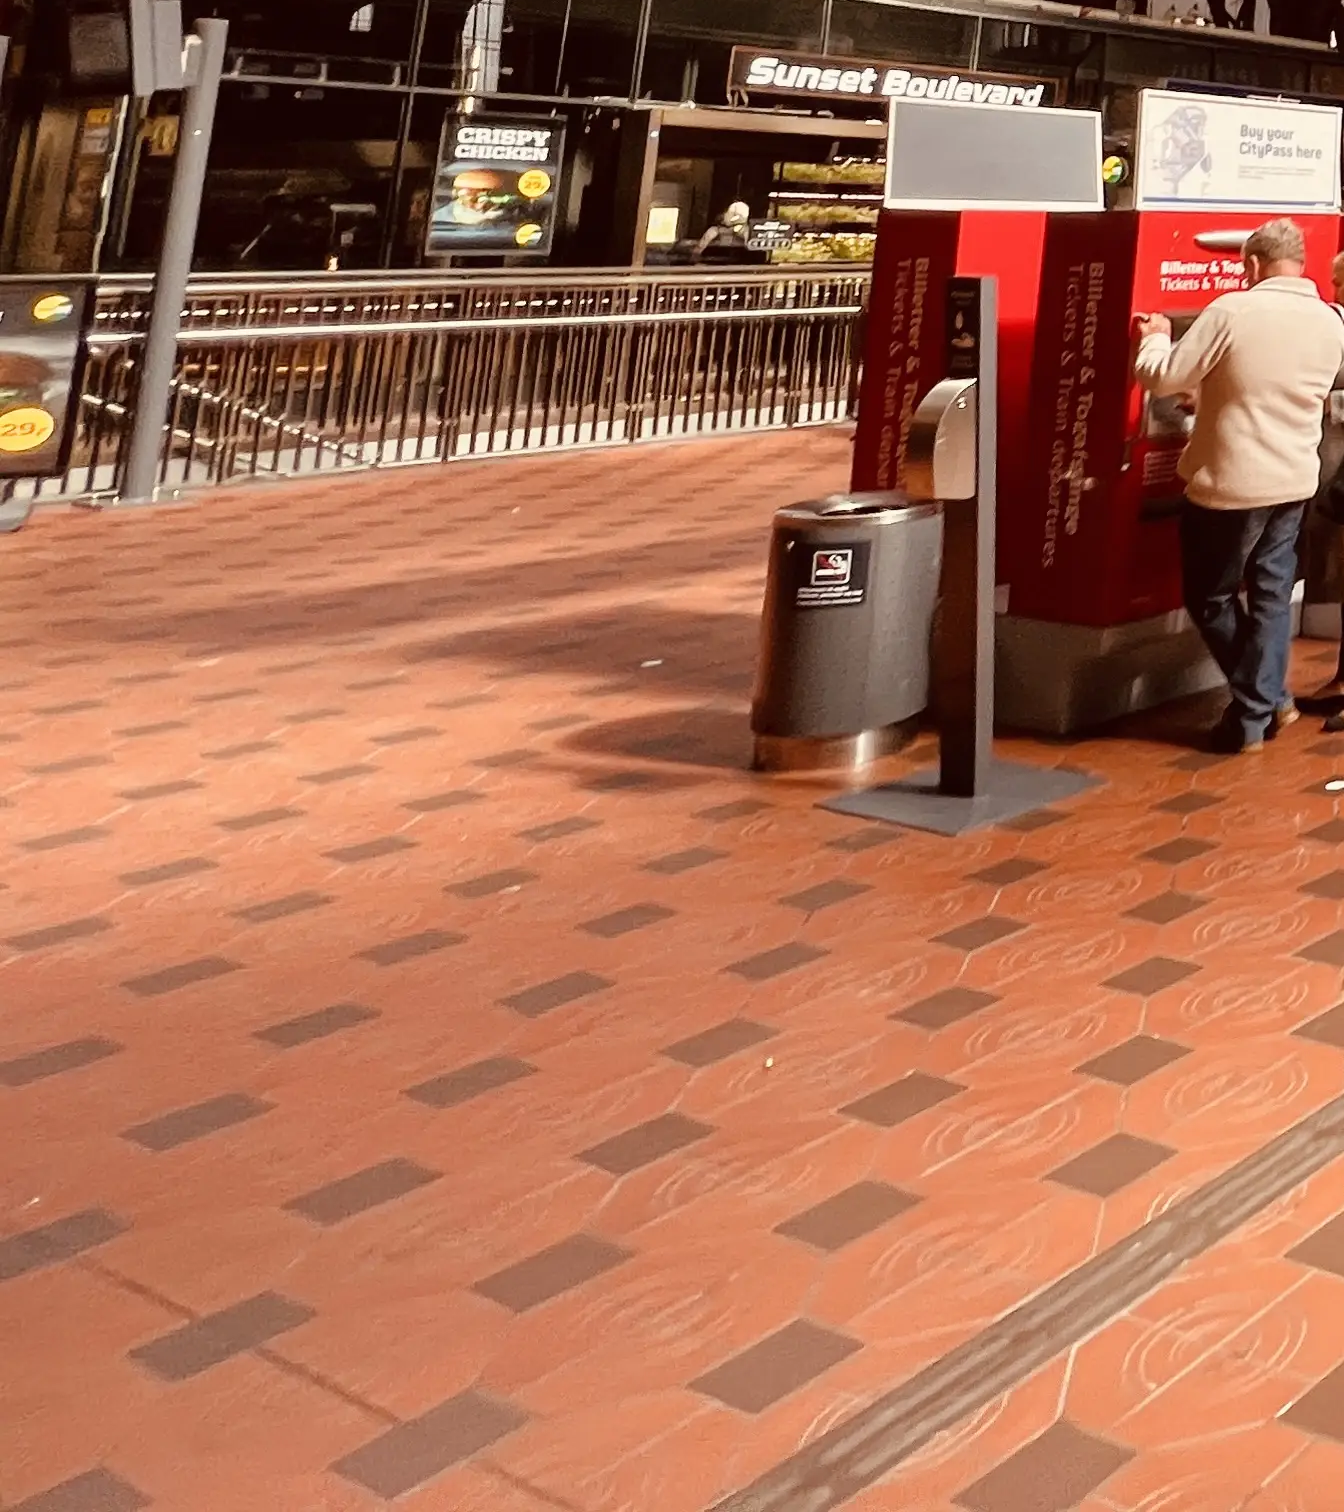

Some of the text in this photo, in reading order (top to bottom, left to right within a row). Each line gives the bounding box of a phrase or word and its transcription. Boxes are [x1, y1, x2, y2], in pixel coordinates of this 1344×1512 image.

[746, 57, 1044, 108] Sunset Boulevard
[457, 128, 551, 147] CRISPY
[1240, 124, 1294, 142] Buy your
[454, 144, 549, 161] CHICKEN
[1239, 141, 1322, 159] CityPass here
[1161, 260, 1209, 275] Billetter
[1209, 260, 1220, 275] &
[1160, 277, 1200, 291] Tickets
[1201, 276, 1211, 290] &
[1213, 276, 1240, 290] Train
[1063, 263, 1085, 342] Tickets
[1081, 262, 1105, 360] Billetter
[1060, 349, 1077, 368] &
[1079, 365, 1096, 385] &
[1055, 375, 1075, 432] Train
